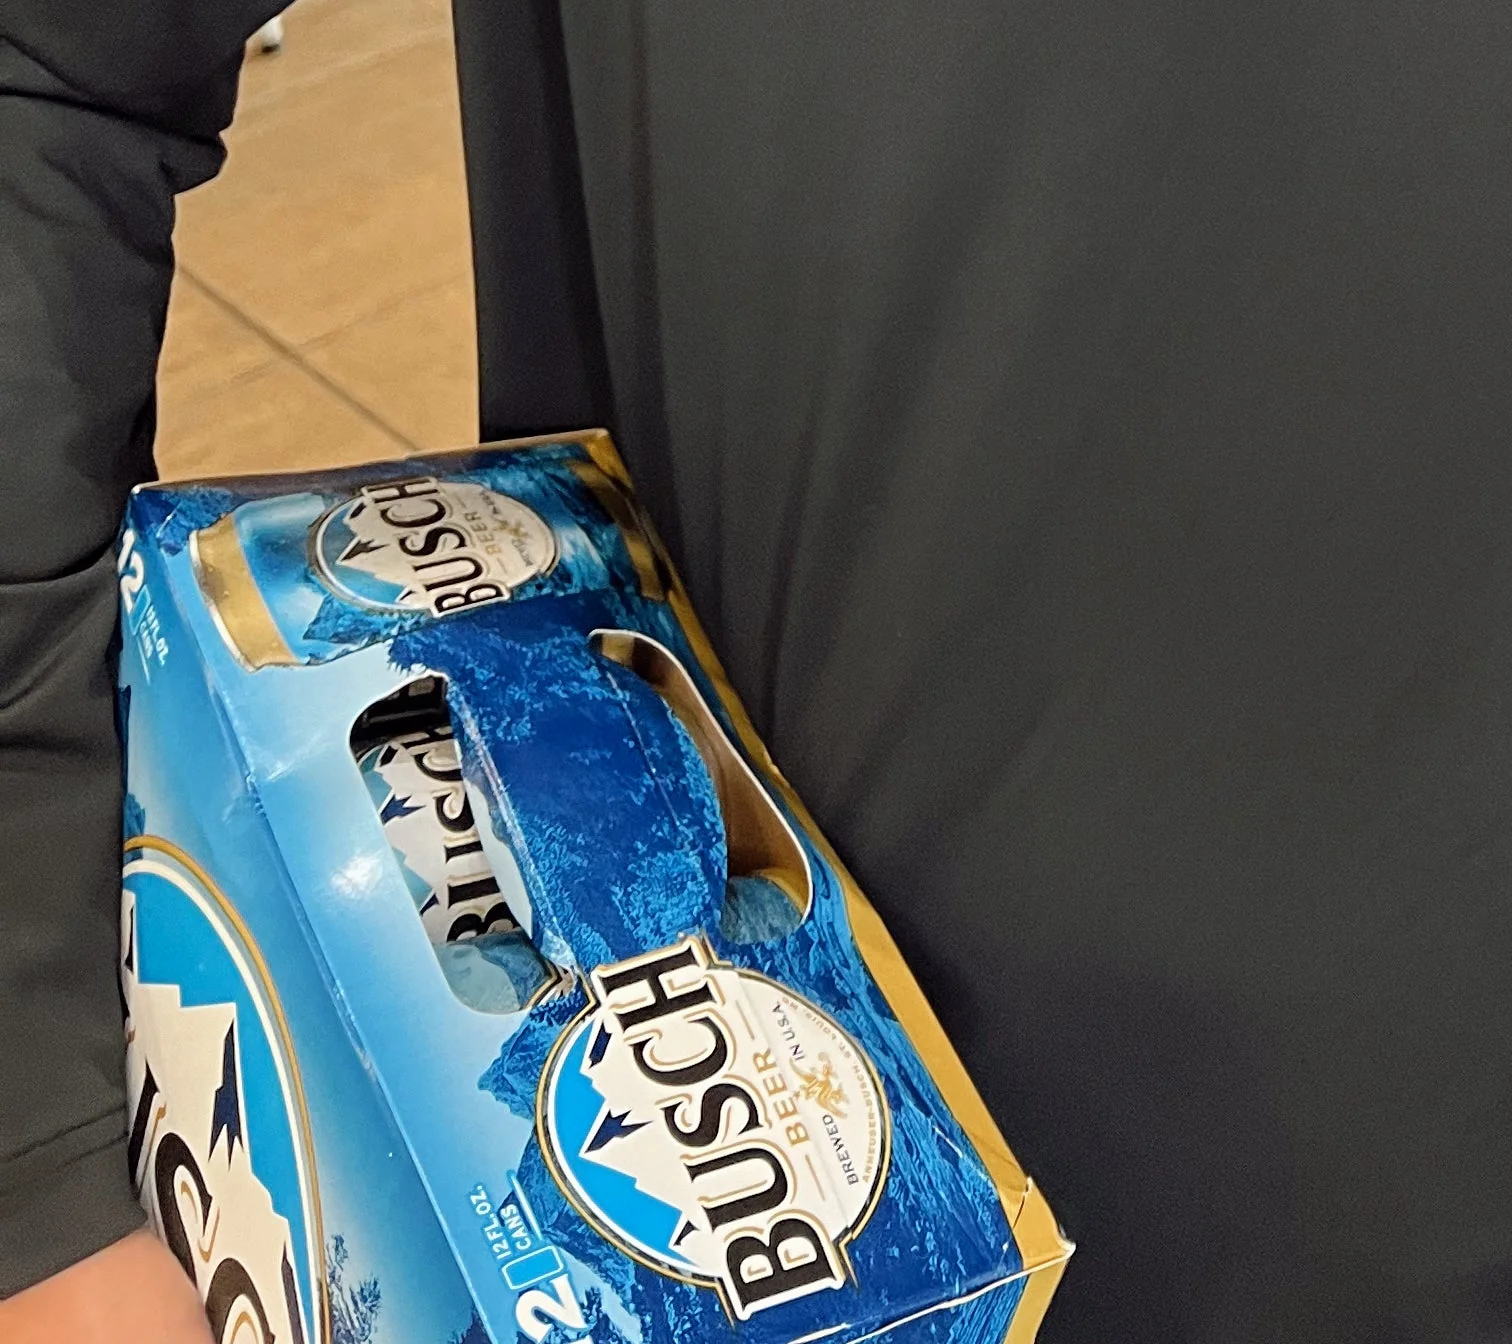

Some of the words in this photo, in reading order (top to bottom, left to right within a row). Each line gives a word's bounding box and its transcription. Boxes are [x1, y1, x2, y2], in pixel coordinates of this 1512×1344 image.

[363, 477, 505, 614] BUSCH
[463, 510, 502, 557] BEER
[788, 1043, 806, 1062] IN
[752, 1047, 811, 1147] BEER
[602, 941, 833, 1314] BUSCH
[821, 1113, 860, 1186] BREWED
[469, 1184, 492, 1217] OZ.
[483, 1212, 504, 1243] FL.
[491, 1235, 513, 1262] 12
[500, 1203, 532, 1251] CANS
[515, 1272, 594, 1344] 2
